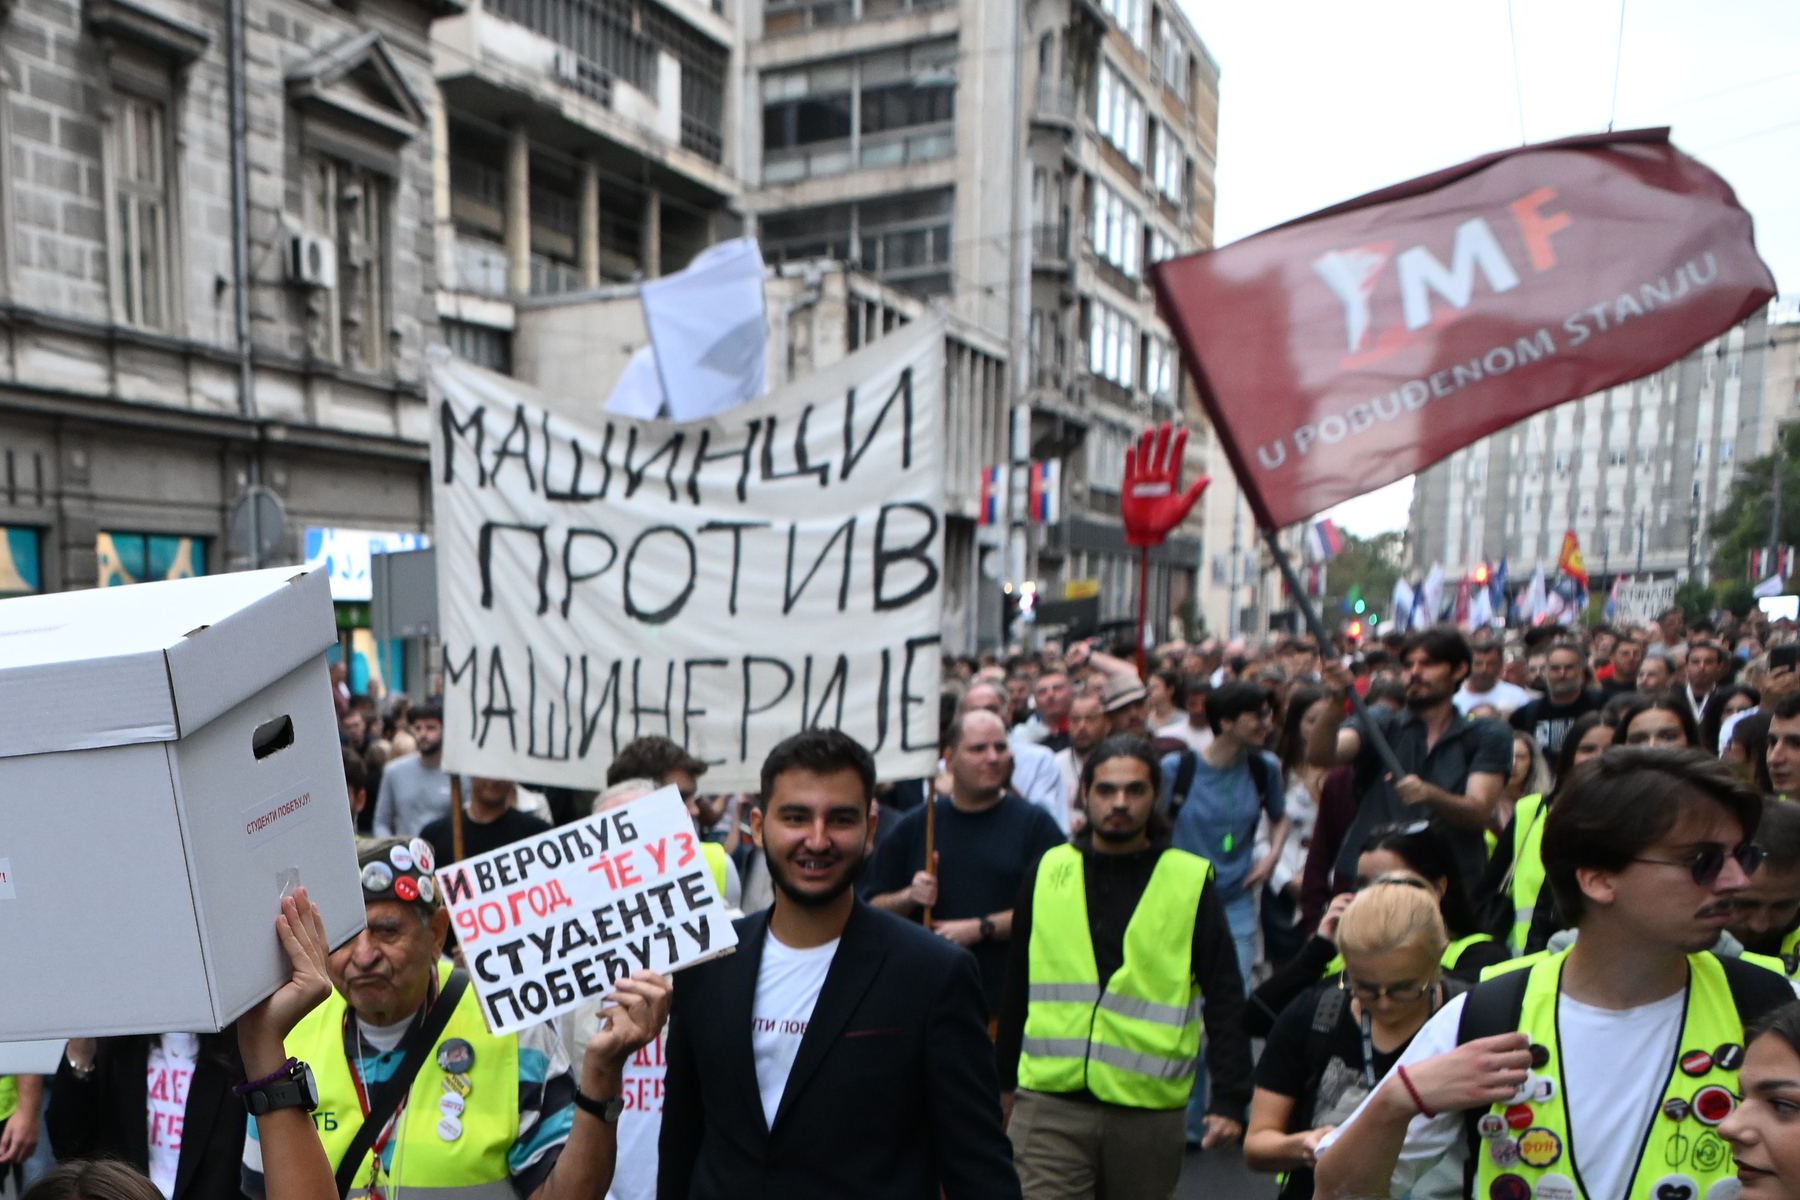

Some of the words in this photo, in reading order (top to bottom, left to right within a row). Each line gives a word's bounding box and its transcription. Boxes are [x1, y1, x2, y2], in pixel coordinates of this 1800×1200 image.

[1256, 437, 1288, 470] U
[1561, 252, 1719, 347] STANJU
[439, 365, 913, 503] МАШИНЦИ
[478, 501, 940, 626] ПРОТИВ
[442, 635, 942, 766] МАШИНЕРИЈЕ
[246, 809, 278, 835] СТУДЕНТИ
[441, 867, 475, 907] И
[474, 871, 714, 984] СТУДЕНТЕ
